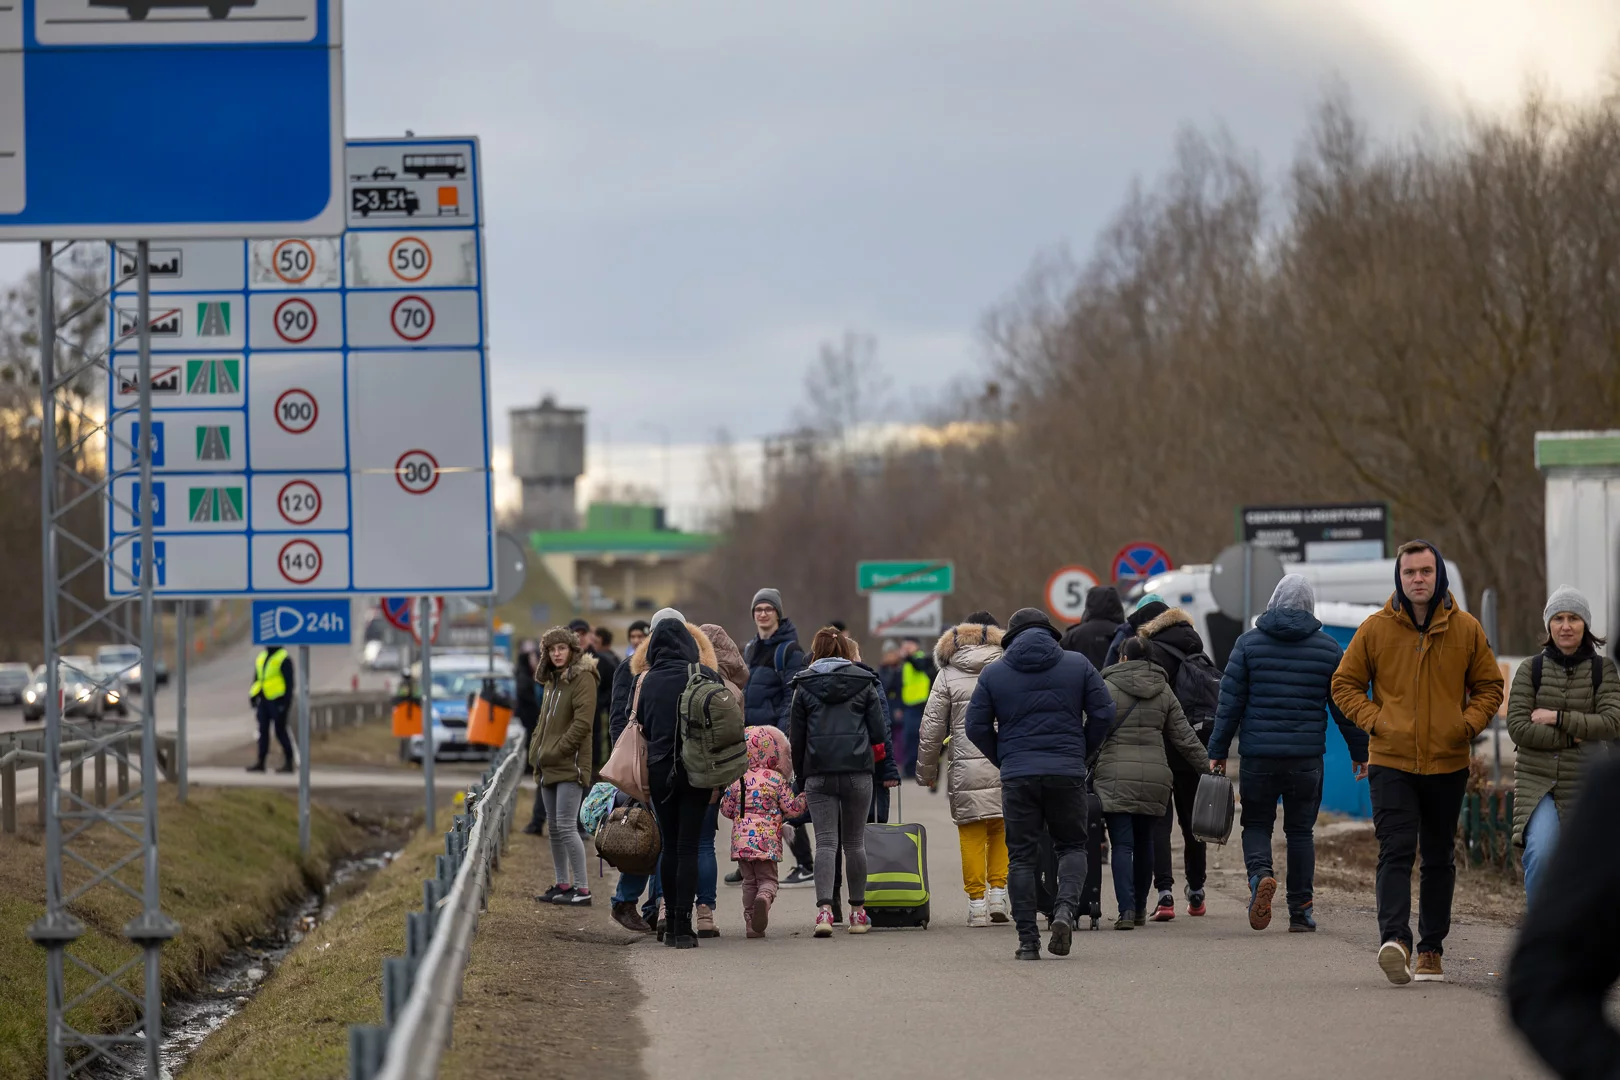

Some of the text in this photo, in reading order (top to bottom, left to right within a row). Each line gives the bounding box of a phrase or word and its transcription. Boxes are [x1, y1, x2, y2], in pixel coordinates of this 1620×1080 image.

[279, 249, 309, 271] 50
[396, 247, 426, 270] 50
[282, 308, 309, 331] 90
[401, 307, 428, 329] 70
[282, 402, 312, 421] 100
[284, 492, 316, 512] 120
[284, 551, 316, 571] 140
[306, 612, 344, 632] 24h
